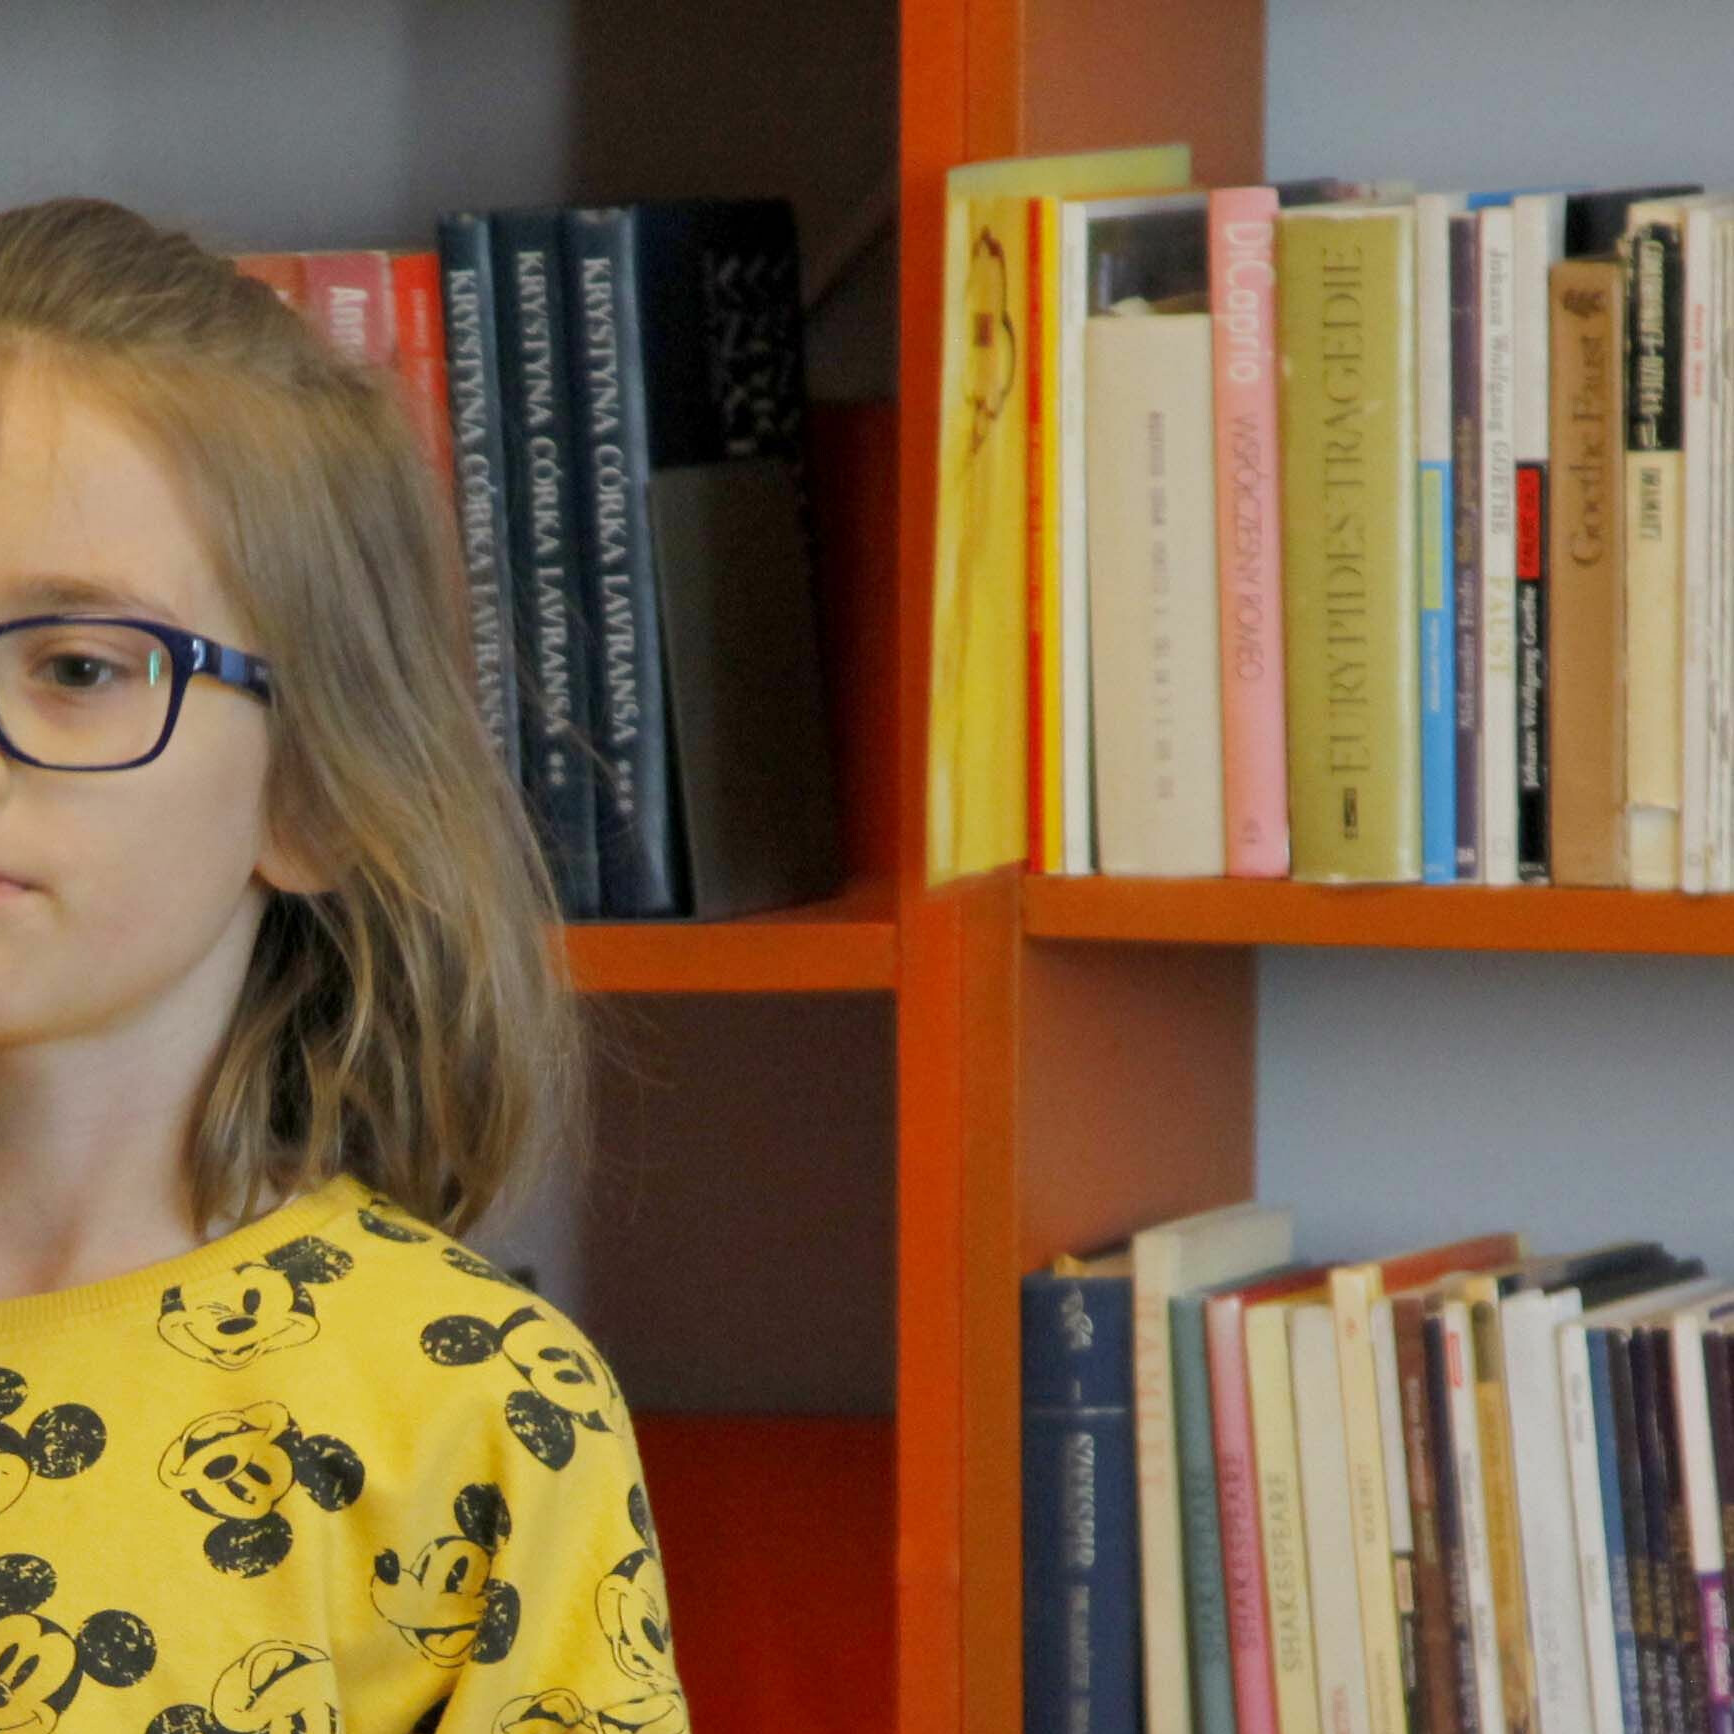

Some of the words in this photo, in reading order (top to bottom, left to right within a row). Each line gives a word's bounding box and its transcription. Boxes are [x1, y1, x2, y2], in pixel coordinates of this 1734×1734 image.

[515, 249, 556, 427] KRYSTYNA
[578, 256, 621, 434] KRYSTYNA
[1216, 219, 1276, 385] DiCaprio
[1487, 249, 1510, 328] Johann
[447, 267, 487, 444] KRYSTYNA
[1318, 243, 1368, 503] TRAGEDIE
[1485, 334, 1510, 433] Wolfgang
[1569, 333, 1608, 425] Faust
[461, 453, 497, 571] CÓRKA
[526, 435, 566, 554] CÓRKA
[592, 443, 630, 563] CÓRKA
[1230, 413, 1267, 587] WSPÓŁCZESNY
[1487, 440, 1511, 536] GOETHE
[1569, 429, 1610, 571] Goethe
[534, 566, 573, 736] LAVRANSA
[601, 573, 641, 745] LAVRANSA
[1234, 592, 1266, 682] ROMEO
[1322, 503, 1373, 777] EURYPIDES
[1488, 575, 1512, 681] FAUST
[1521, 584, 1540, 647] Goethe
[1521, 649, 1542, 727] Wolfgang
[1522, 730, 1541, 789] Johann
[1218, 1450, 1258, 1650] SHAKESPEARE
[1264, 1470, 1306, 1673] SHAKESPEARE
